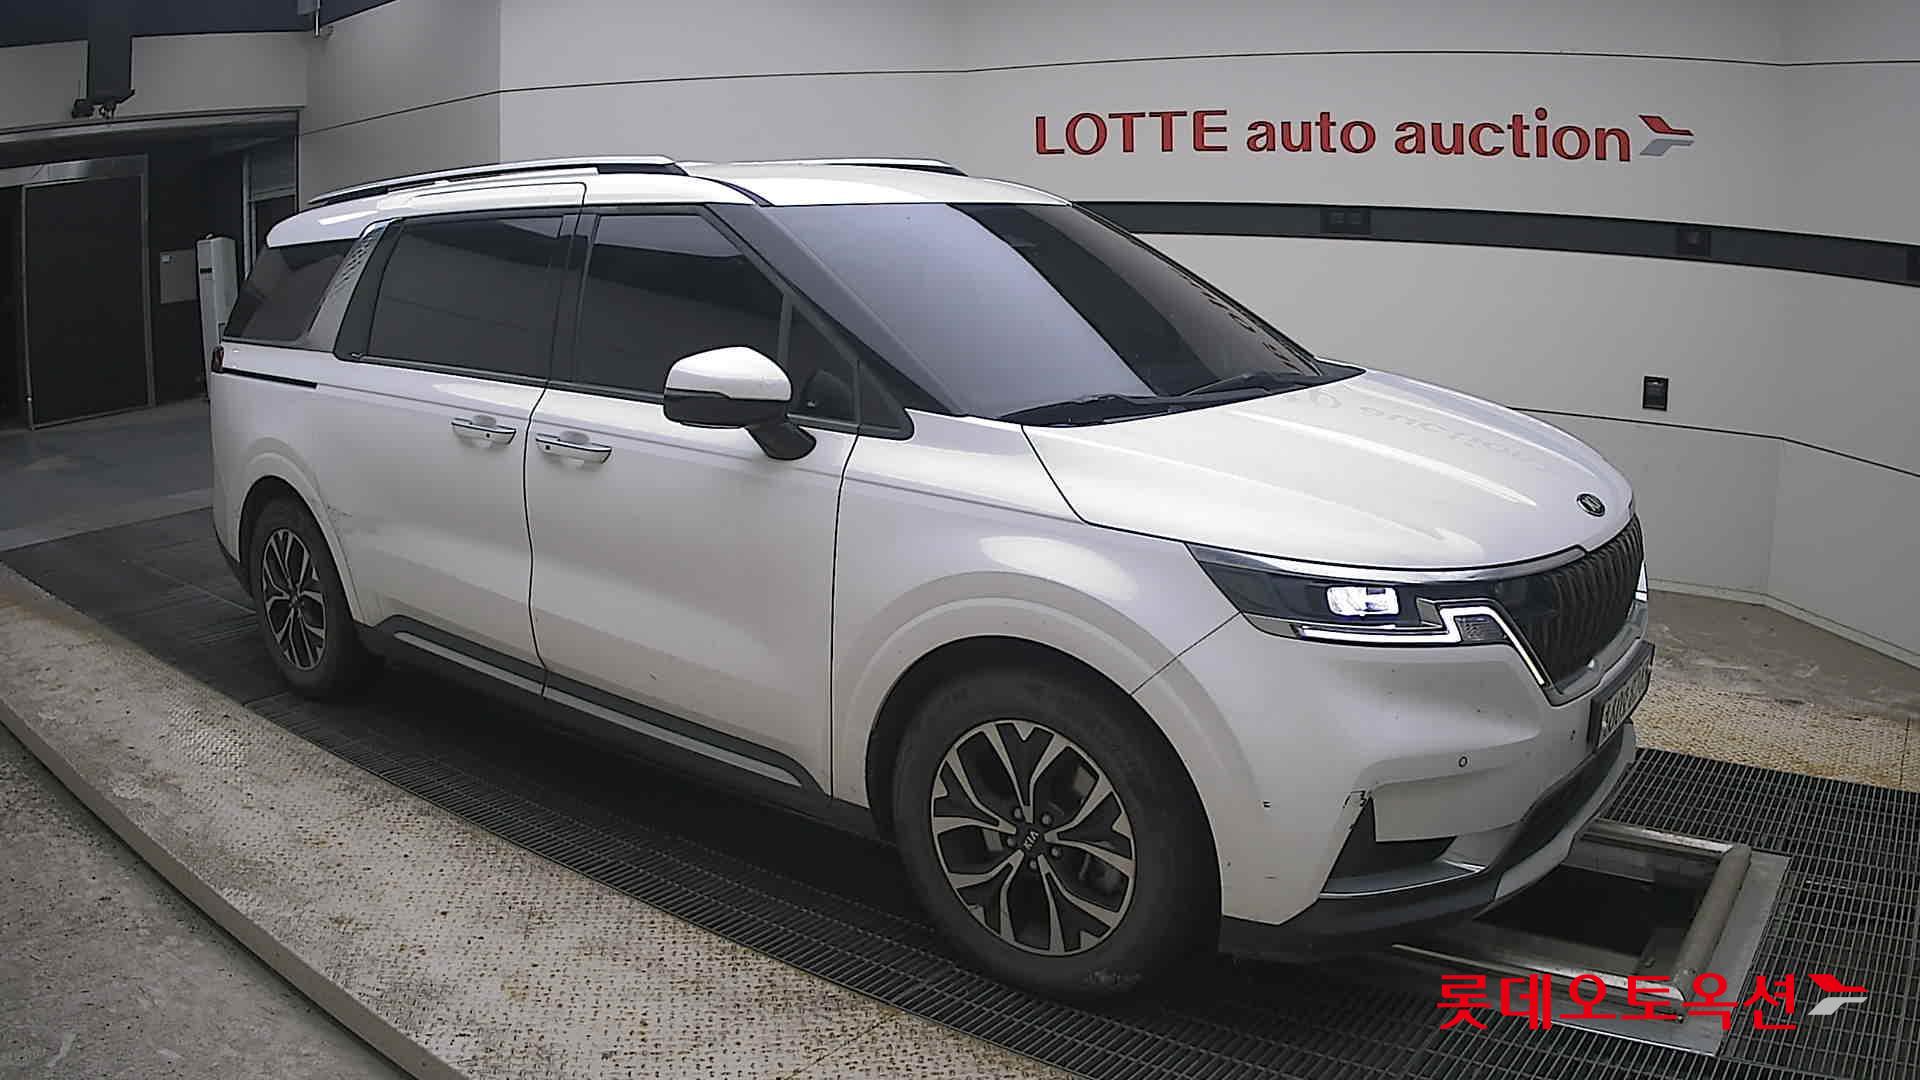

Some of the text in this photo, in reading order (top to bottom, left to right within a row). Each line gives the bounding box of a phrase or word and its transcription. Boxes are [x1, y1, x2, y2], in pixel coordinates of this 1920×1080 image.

[1035, 107, 1631, 162] LOTTE auto auction
